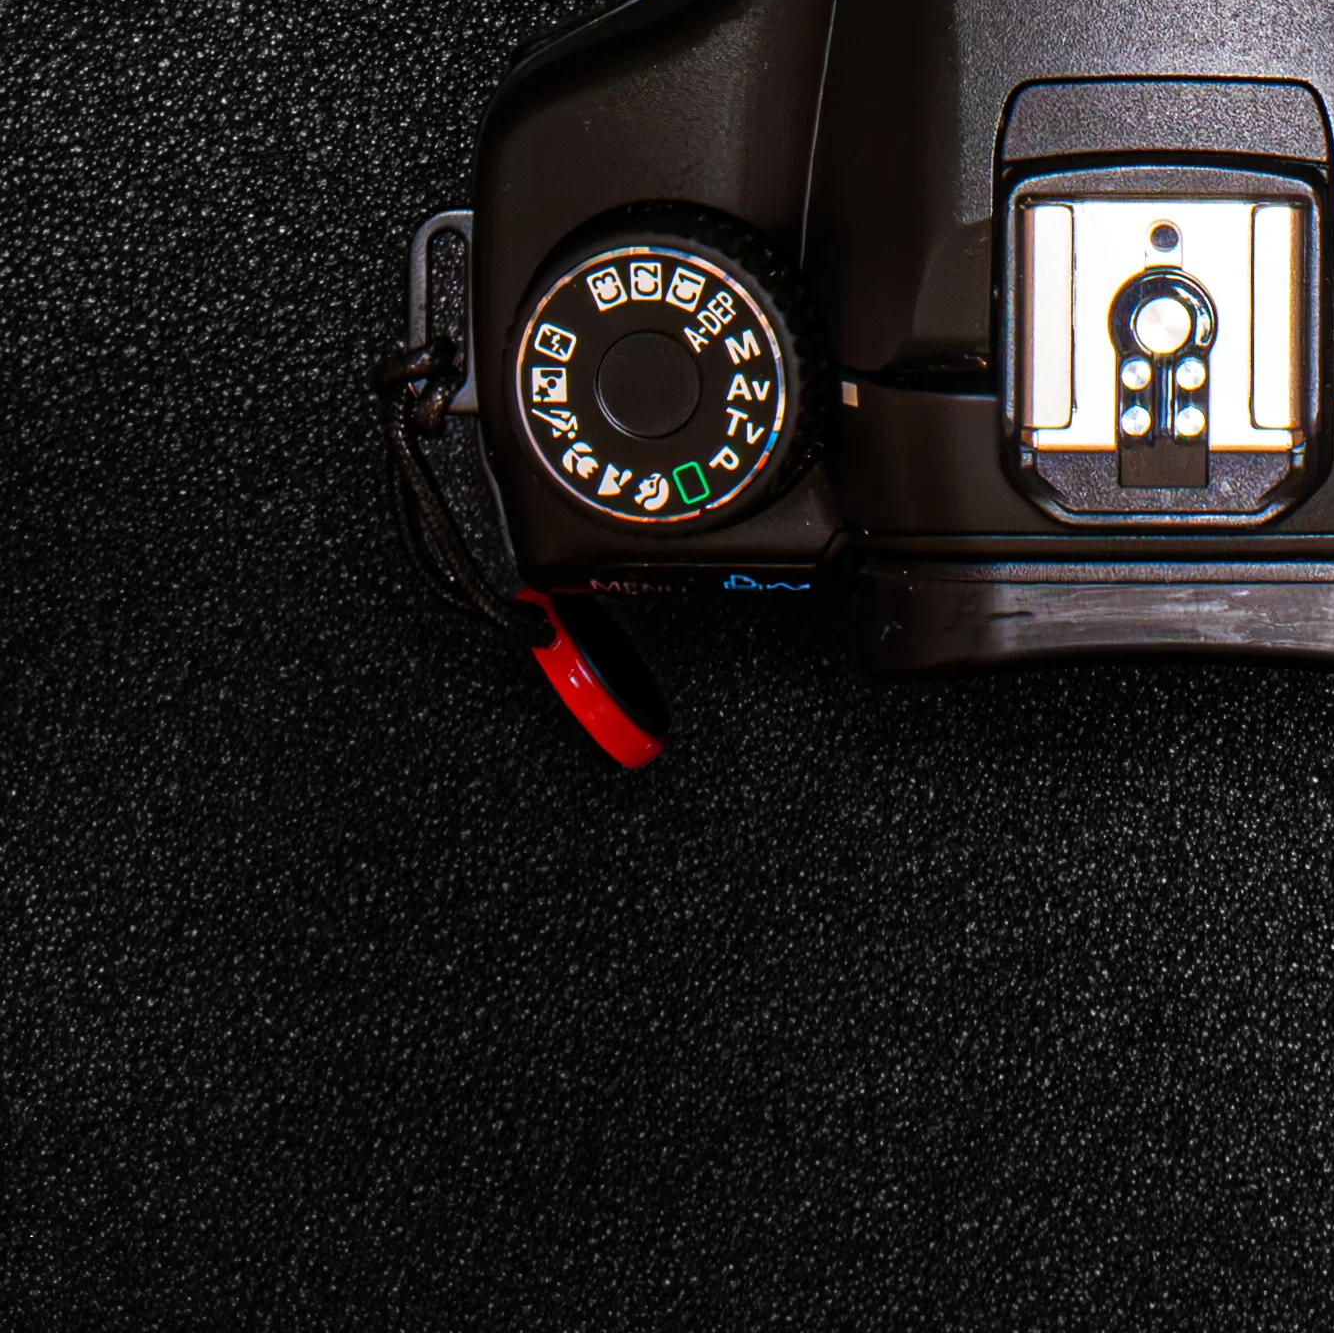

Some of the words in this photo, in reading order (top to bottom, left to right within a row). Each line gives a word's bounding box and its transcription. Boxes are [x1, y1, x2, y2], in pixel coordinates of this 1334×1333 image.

[592, 270, 624, 307] C3
[632, 263, 660, 297] C2
[671, 272, 707, 305] C1
[683, 290, 737, 354] A-DEP
[725, 329, 762, 365] M
[726, 373, 771, 402] Av
[726, 407, 765, 445] Tv
[708, 445, 740, 472] P
